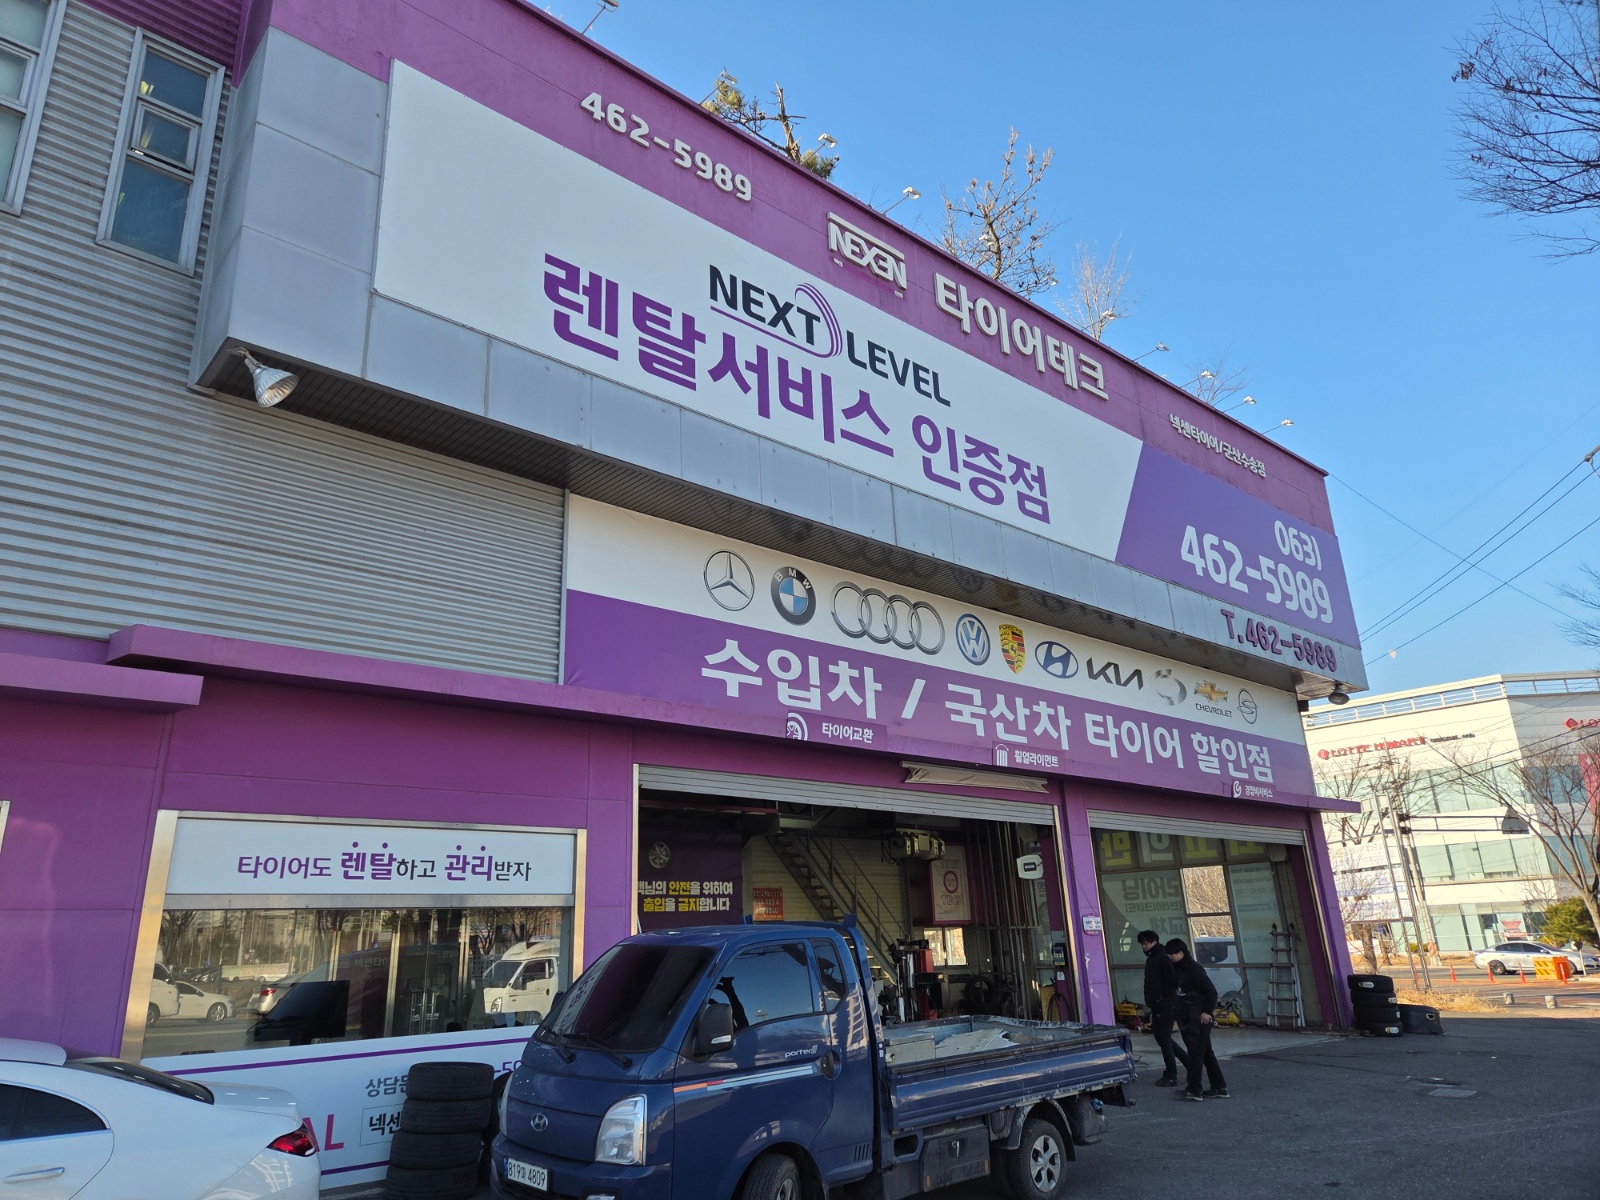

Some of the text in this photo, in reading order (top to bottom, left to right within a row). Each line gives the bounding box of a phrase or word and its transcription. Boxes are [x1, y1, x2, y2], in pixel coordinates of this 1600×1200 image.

[580, 91, 753, 202] 462-5989
[827, 216, 907, 290] NEXEN
[709, 263, 951, 407] NEXT LEVEL
[934, 272, 1110, 400] 타이어테크
[543, 252, 1051, 525] 렌탈서비스 인증점
[1180, 524, 1334, 624] 462-5989
[1274, 520, 1322, 571] 063)
[774, 567, 812, 589] BMW
[1220, 608, 1338, 673] T.462-5989
[701, 638, 882, 720] 수입차
[944, 682, 1072, 751] 국산차
[1084, 710, 1185, 769] 타이어
[1190, 731, 1274, 784] 할인점
[821, 721, 874, 745] 타이어교환
[1195, 702, 1233, 720] CHEVROLET
[237, 851, 532, 882] 타이어도 렌탈하고 관리받자
[668, 881, 701, 896] 안전을
[702, 881, 733, 896] 위하여
[643, 897, 731, 912] 출입을 금지합니다
[528, 1168, 546, 1187] 4809
